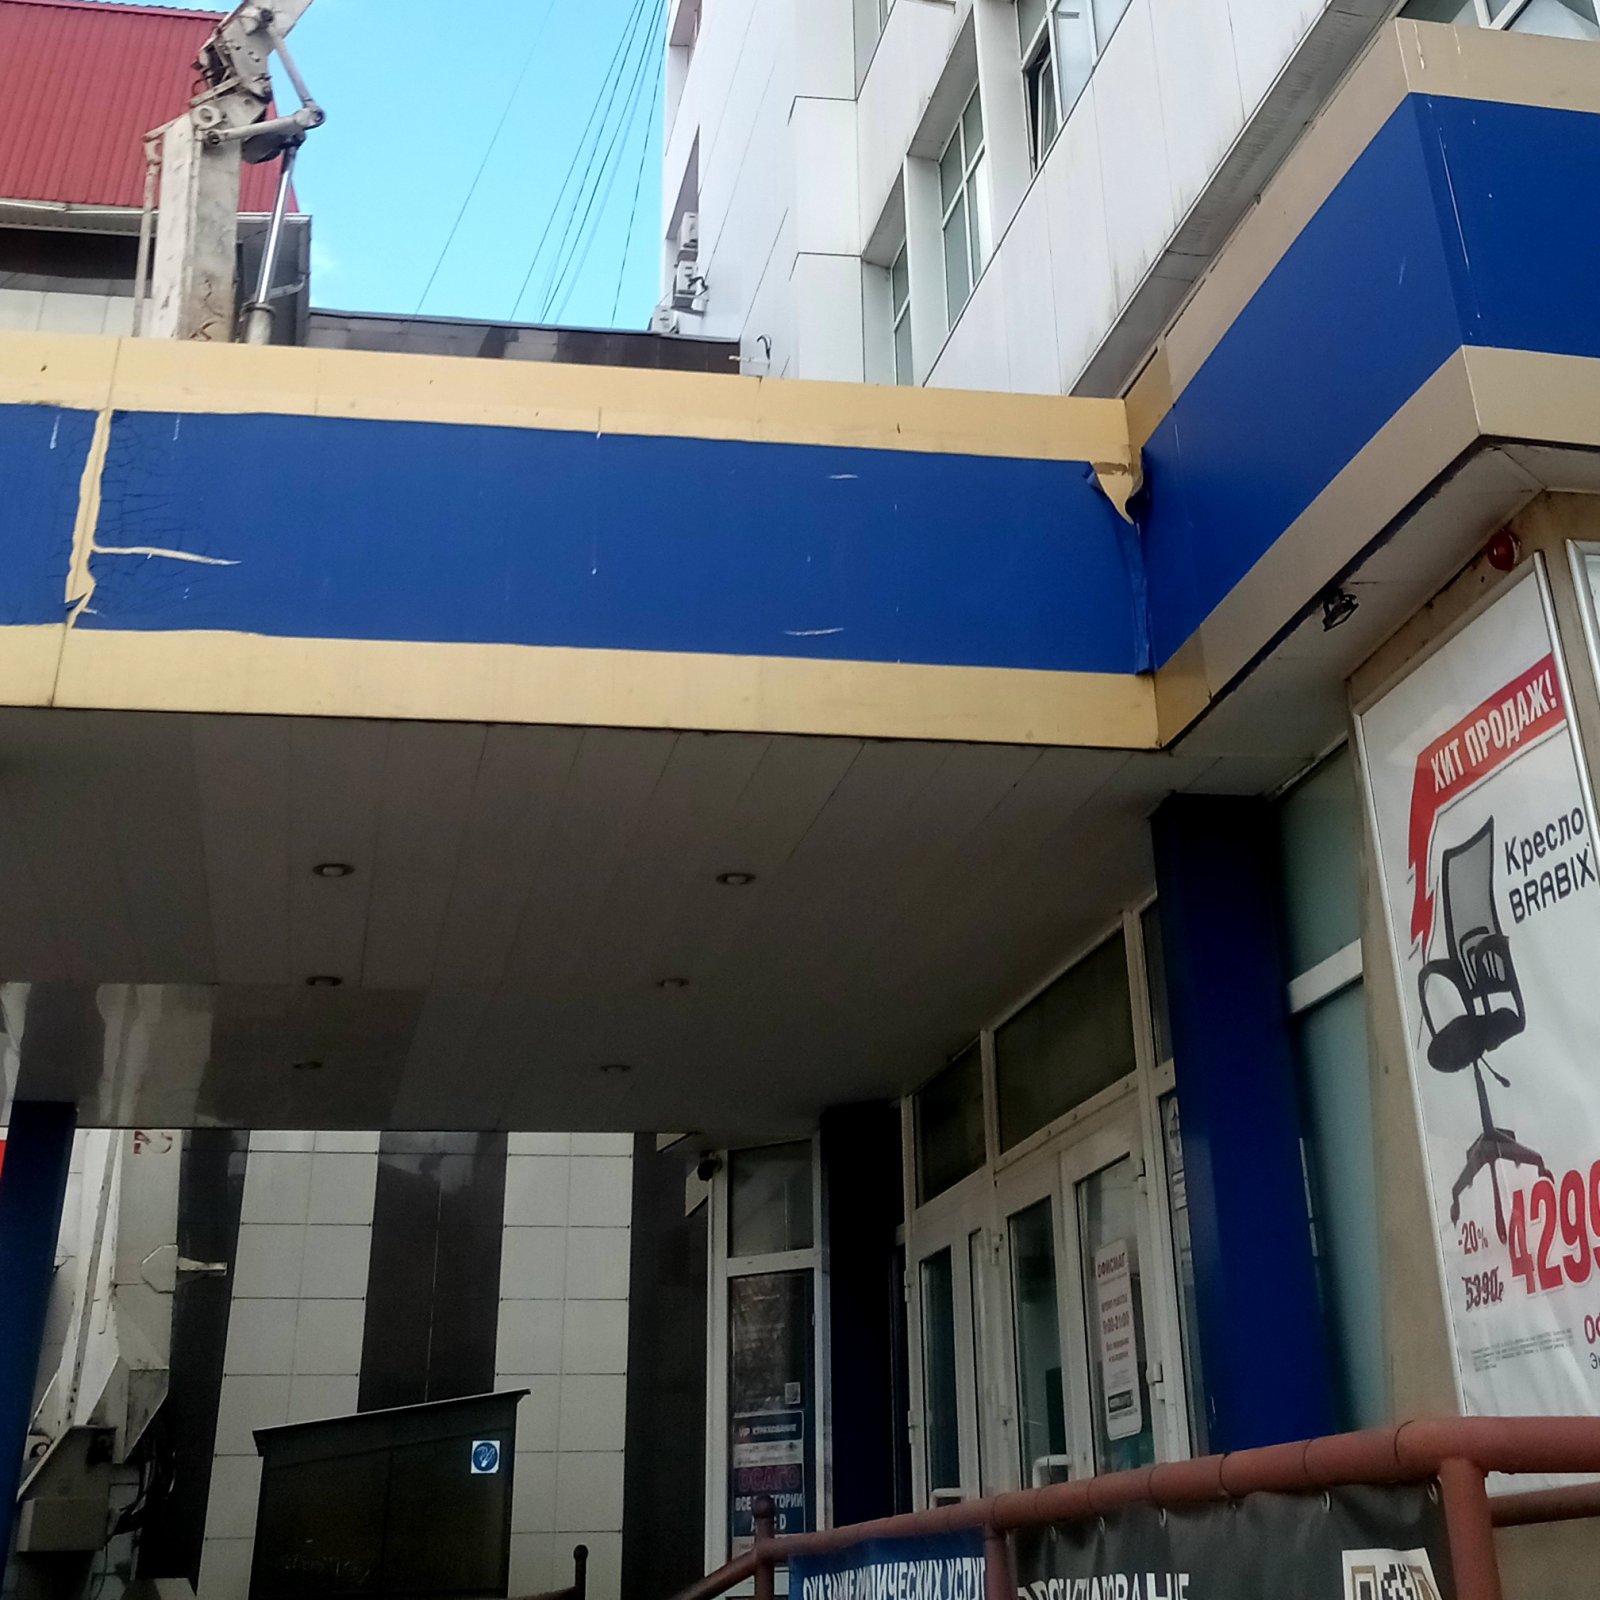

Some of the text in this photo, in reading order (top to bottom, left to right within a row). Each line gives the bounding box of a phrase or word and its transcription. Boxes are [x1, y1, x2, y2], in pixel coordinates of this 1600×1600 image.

[1431, 669, 1558, 794] ХИТ ПРОДАЖ!
[1504, 807, 1585, 877] Кресло
[1508, 847, 1596, 924] BRABIX
[1458, 1220, 1489, 1255] -20%
